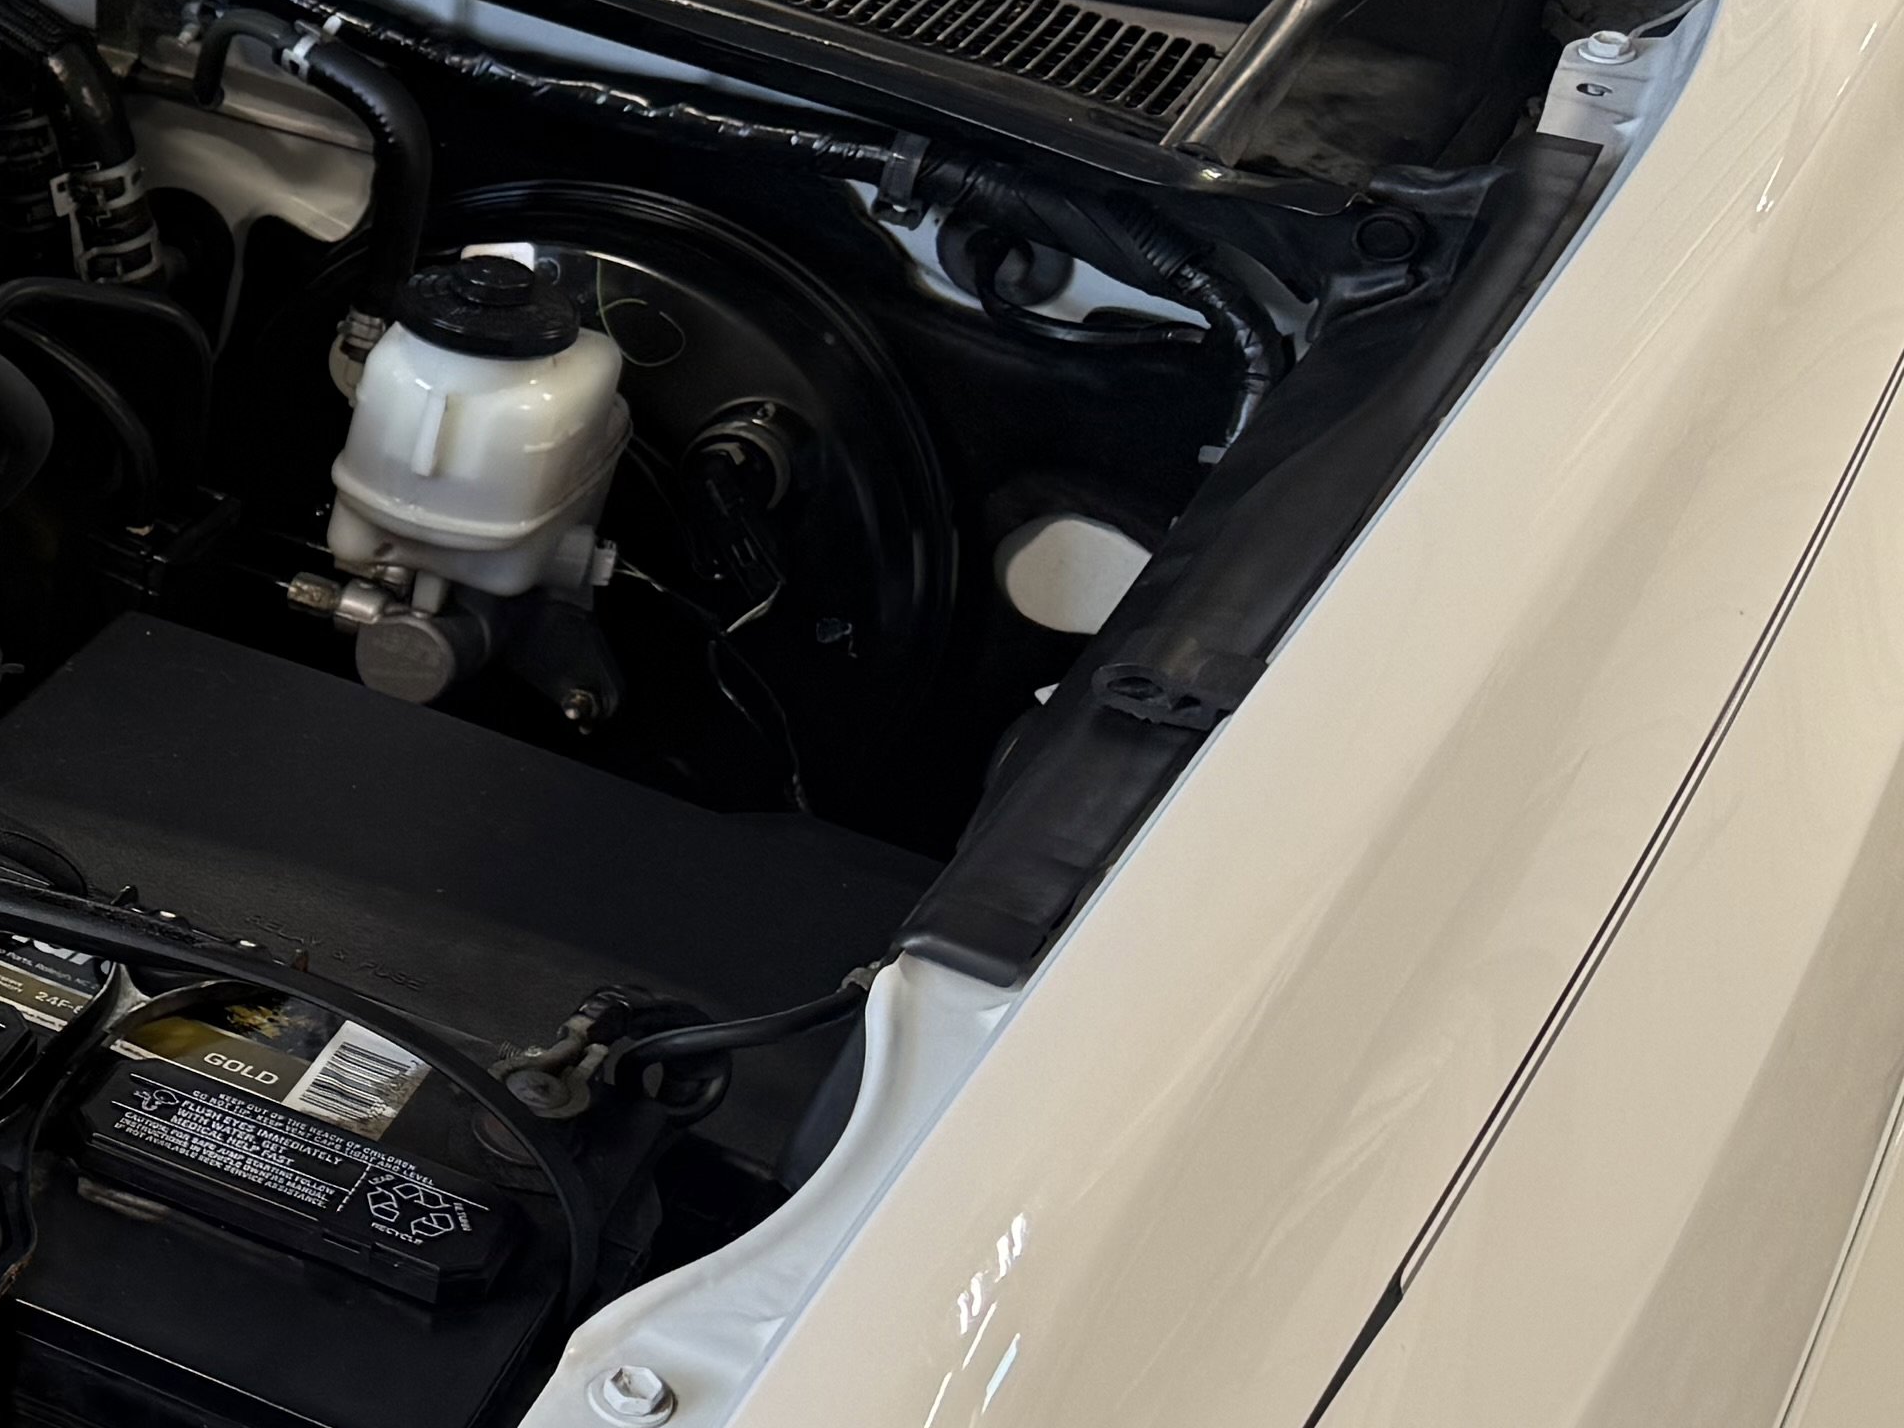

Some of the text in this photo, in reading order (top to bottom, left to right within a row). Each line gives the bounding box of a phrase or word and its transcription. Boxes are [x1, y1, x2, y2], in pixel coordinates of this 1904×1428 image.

[203, 1050, 281, 1086] GOLD
[171, 1115, 294, 1165] MEDICAL HELP FAST
[176, 1108, 209, 1124] WITH
[262, 1140, 286, 1153] GET
[181, 1100, 341, 1165] FLUSH EYES IMMEDIATELY
[295, 1176, 335, 1194] FOLLOW
[403, 1169, 436, 1185] LEVEL
[370, 1222, 423, 1245] RECYCLE
